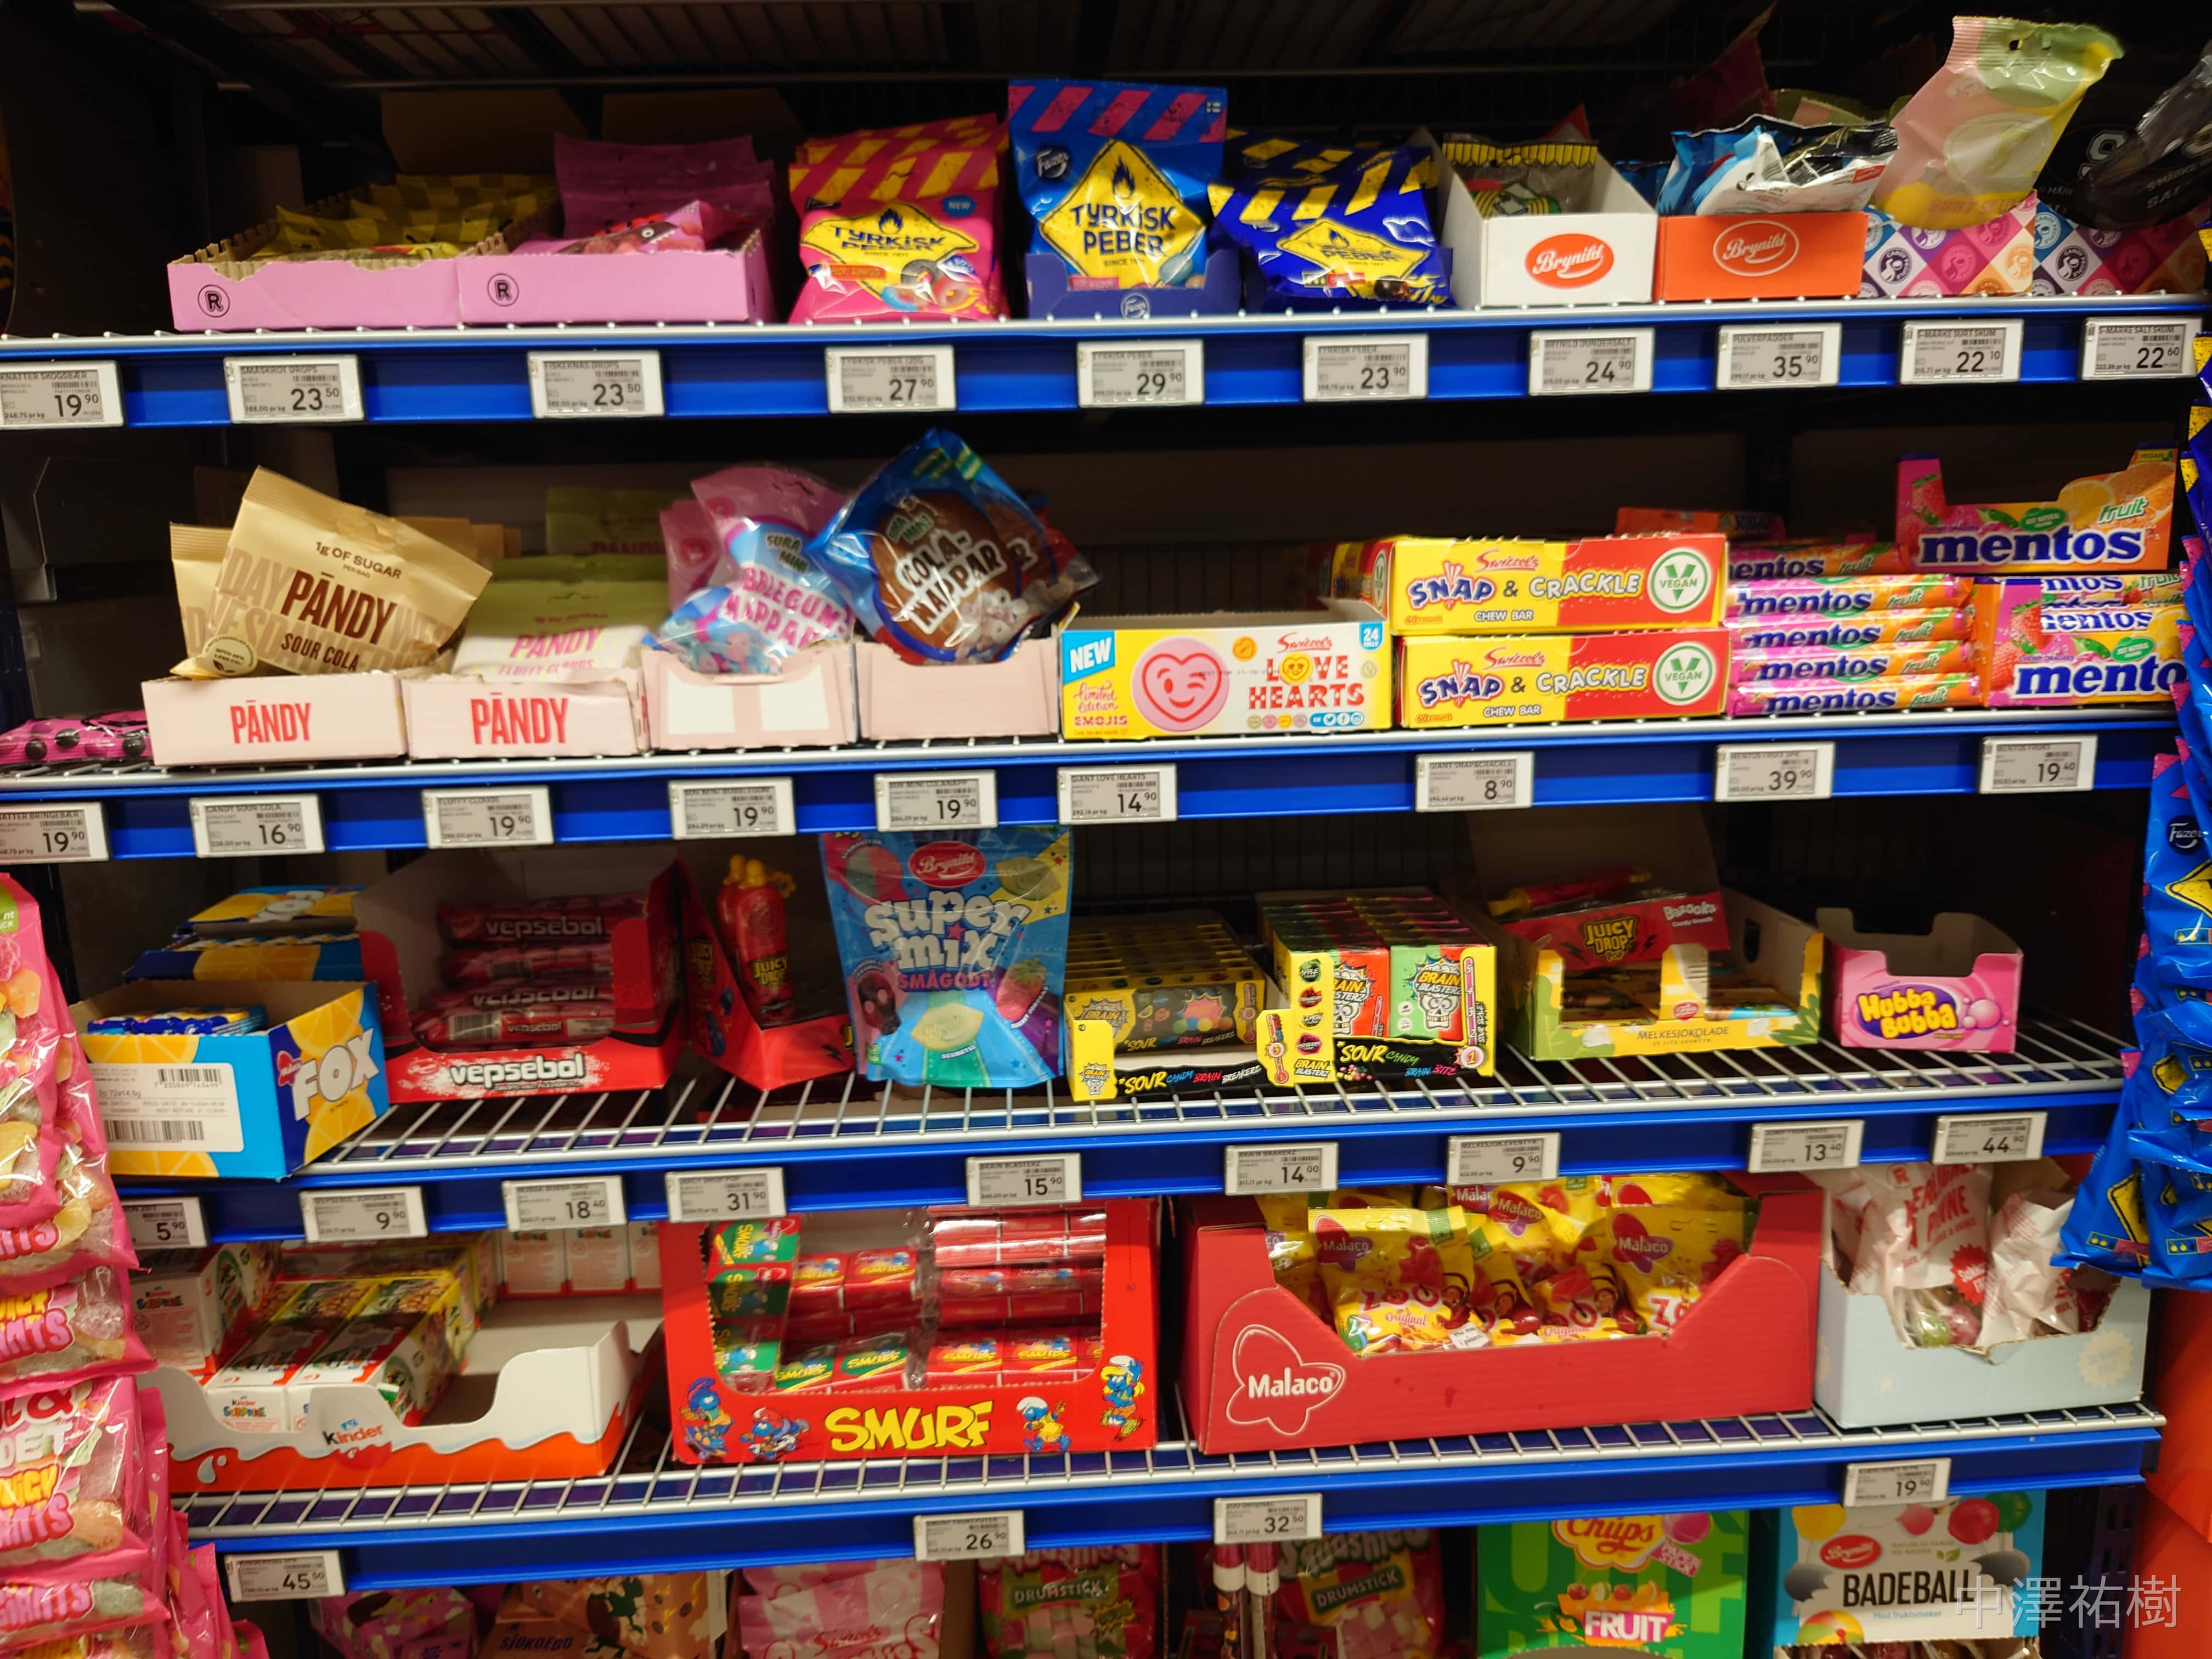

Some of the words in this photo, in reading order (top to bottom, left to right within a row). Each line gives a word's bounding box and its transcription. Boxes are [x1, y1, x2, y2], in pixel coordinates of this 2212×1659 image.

[949, 201, 970, 210] NEW
[1084, 230, 1164, 256] PEBER
[1722, 233, 1787, 264] Brynild
[1532, 244, 1605, 279] Brynild
[206, 290, 223, 311] R
[495, 280, 511, 301] R
[1773, 356, 1802, 378] 35
[1805, 355, 1819, 364] 90
[1956, 351, 1984, 373] 22
[1990, 351, 2001, 360] 10
[2136, 347, 2164, 369] 22
[2167, 347, 2180, 356] 60
[1137, 373, 1166, 396] 29
[1169, 373, 1182, 382] 90
[54, 394, 82, 417] 19
[84, 394, 99, 403] 90
[291, 388, 323, 411] 23
[325, 387, 340, 397] 50
[2098, 498, 2147, 523] fruit
[767, 535, 802, 551] SURA
[1922, 526, 2142, 563] mentos
[315, 541, 331, 556] 1g
[332, 548, 353, 561] OF
[353, 554, 402, 579] SUGAR
[778, 550, 810, 572] MINI
[1475, 549, 1539, 572] Swizzels
[343, 565, 357, 573] PER
[357, 570, 370, 578] BAG
[1408, 575, 1496, 608] SNAP
[1503, 580, 1517, 597] &
[1530, 572, 1640, 599] CRACKLE
[1660, 578, 1698, 588] VEGAN
[1742, 589, 1872, 616] mentos
[1475, 610, 1506, 622] CHEW
[1511, 610, 1534, 621] BAR
[1276, 632, 1333, 653] Swizzels
[1363, 628, 1379, 641] 24
[281, 633, 319, 658] SOUR
[323, 646, 360, 672] COLA
[1070, 637, 1111, 673] NEW
[1483, 645, 1545, 669] Swizzels
[1664, 671, 1702, 682] VEGAN
[1758, 657, 1888, 680] mentos
[2016, 655, 2188, 695] mento
[1249, 683, 1364, 709] HEARTS
[1419, 674, 1502, 707] SNAP
[1510, 678, 1525, 693] &
[1537, 667, 1647, 693] CRACKLE
[1483, 706, 1515, 717] CHEW
[1520, 705, 1541, 715] BAR
[1765, 690, 1897, 712] mentos
[229, 699, 312, 744] PĀNDY
[470, 692, 568, 744] PĀNDY
[1075, 716, 1127, 725] EMOJIS
[2038, 763, 2060, 782] 19
[2063, 762, 2075, 771] 40
[1485, 780, 1497, 800] 8
[1500, 780, 1513, 788] 90
[1118, 793, 1142, 813] 14
[1144, 792, 1157, 800] 90
[258, 824, 286, 844] 16
[287, 823, 301, 832] 90
[489, 816, 515, 836] 19
[517, 815, 531, 824] 90
[42, 832, 69, 853] 19
[71, 831, 85, 840] 90
[917, 852, 977, 879] Brynild
[486, 916, 603, 938] vepsebol
[865, 890, 1031, 947] super
[1585, 917, 1637, 945] JUICY
[1594, 935, 1628, 956] DROP
[1299, 968, 1319, 976] APPLE
[1418, 972, 1462, 985] BRAIN
[1086, 1011, 1119, 1020] BRAIN
[1857, 988, 1936, 1023] Hubba
[1302, 1013, 1323, 1023] LEMON
[1880, 1003, 1957, 1039] Bubba
[1637, 1025, 1729, 1040] MELKESJOKOLADE
[1294, 1059, 1328, 1070] BRAIN
[1340, 1045, 1387, 1063] SOUR
[1386, 1051, 1421, 1066] CANDY
[291, 1028, 379, 1122] FOX
[449, 1053, 586, 1090] vepsebol
[1166, 1070, 1193, 1084] CANDY
[1192, 1071, 1222, 1083] BRAIN
[1222, 1065, 1262, 1084] BREAKERZ
[1295, 1068, 1330, 1077] BLASTERZ
[1404, 1067, 1431, 1077] BRAIN
[1432, 1064, 1457, 1076] BITZ
[1983, 1136, 2009, 1153] 44
[1282, 1166, 1304, 1183] 14
[1025, 1178, 1048, 1196] 15
[566, 1200, 591, 1219] 18
[592, 1199, 606, 1207] 40
[727, 1192, 749, 1211] 31
[1498, 1198, 1542, 1218] Malaco
[156, 1222, 171, 1241] 5
[172, 1221, 185, 1229] 90
[1323, 1239, 1370, 1252] Malaco
[1618, 1237, 1669, 1252] Malaco
[847, 1349, 901, 1370] SMURF
[1248, 1367, 1333, 1398] Malaco
[825, 1401, 994, 1453] SMURF
[1265, 1516, 1289, 1533] 32
[1292, 1513, 1304, 1523] 50
[966, 1533, 992, 1550] 26
[1824, 1540, 1874, 1565] Brynild
[283, 1573, 311, 1590] 45
[1015, 1579, 1104, 1604] DRUMSTICK
[1317, 1571, 1398, 1607] DRUMSTICK
[1843, 1570, 1974, 1607] BADEBALL
[1874, 1611, 1891, 1620] Med
[1585, 1610, 1667, 1643] FRUIT
